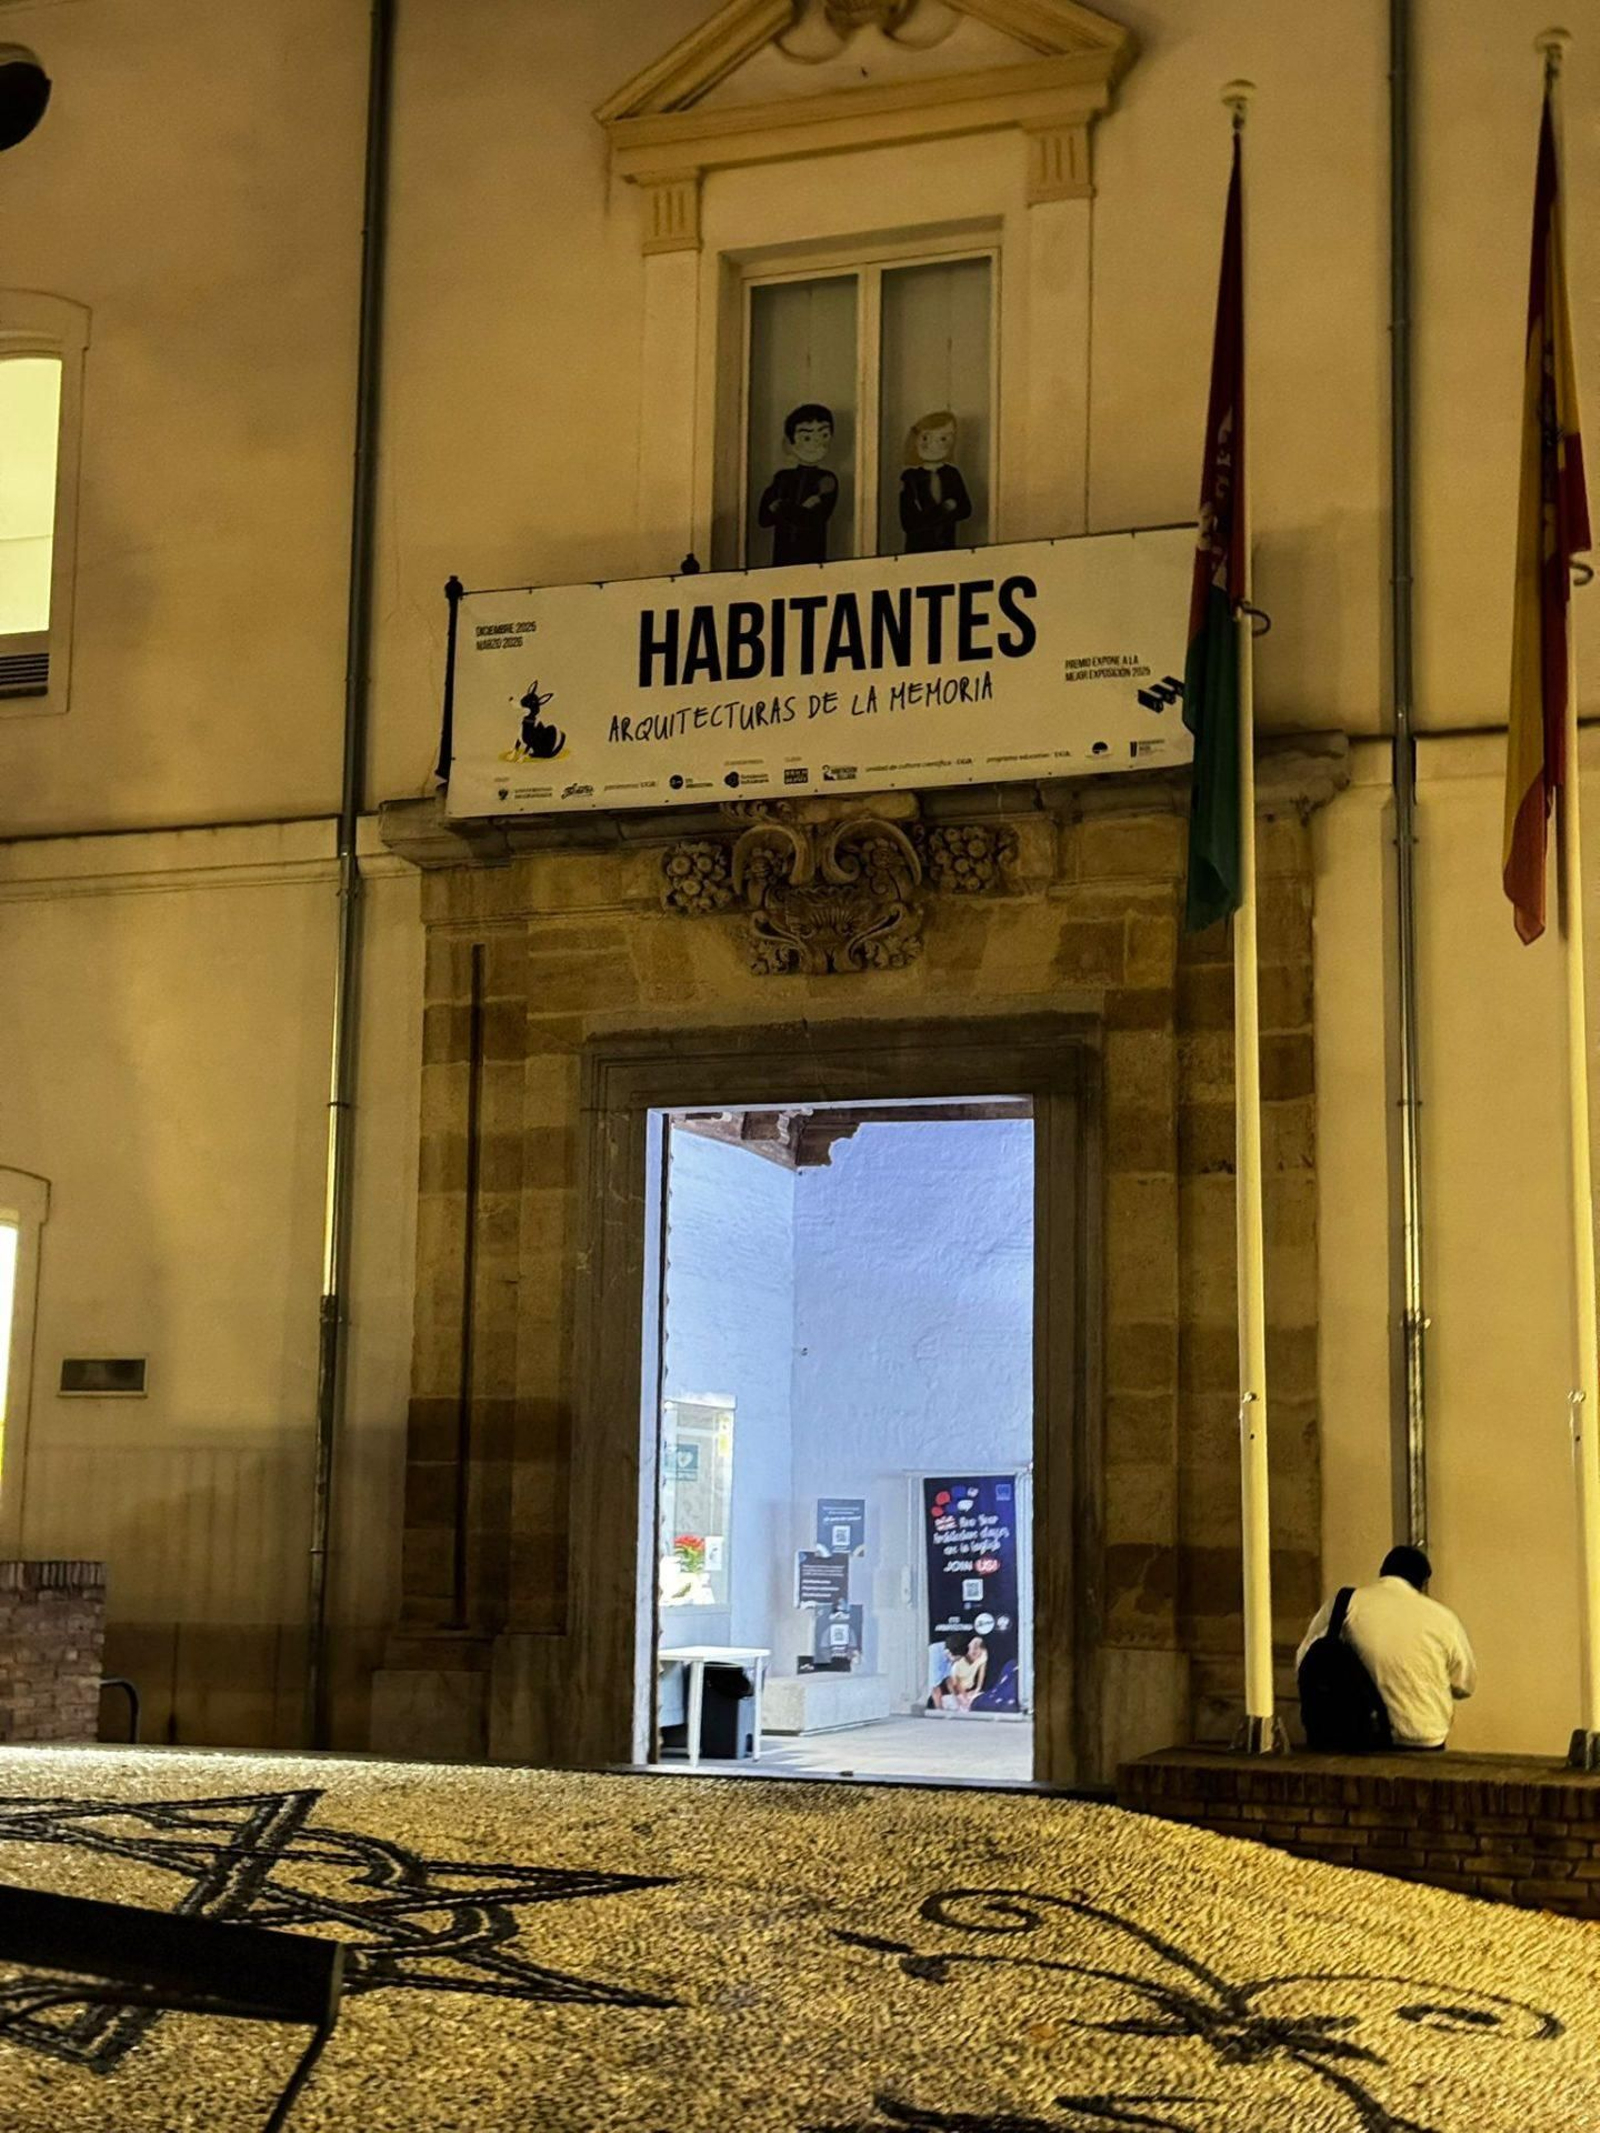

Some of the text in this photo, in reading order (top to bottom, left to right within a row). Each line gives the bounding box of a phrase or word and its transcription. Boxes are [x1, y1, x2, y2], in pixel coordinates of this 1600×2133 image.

[638, 575, 1038, 688] HABITANTES
[1064, 657, 1091, 670] PREMIO
[1065, 670, 1088, 682] MEJOR
[608, 671, 993, 743] ARQUITECTURAS DE LA MEMORIA
